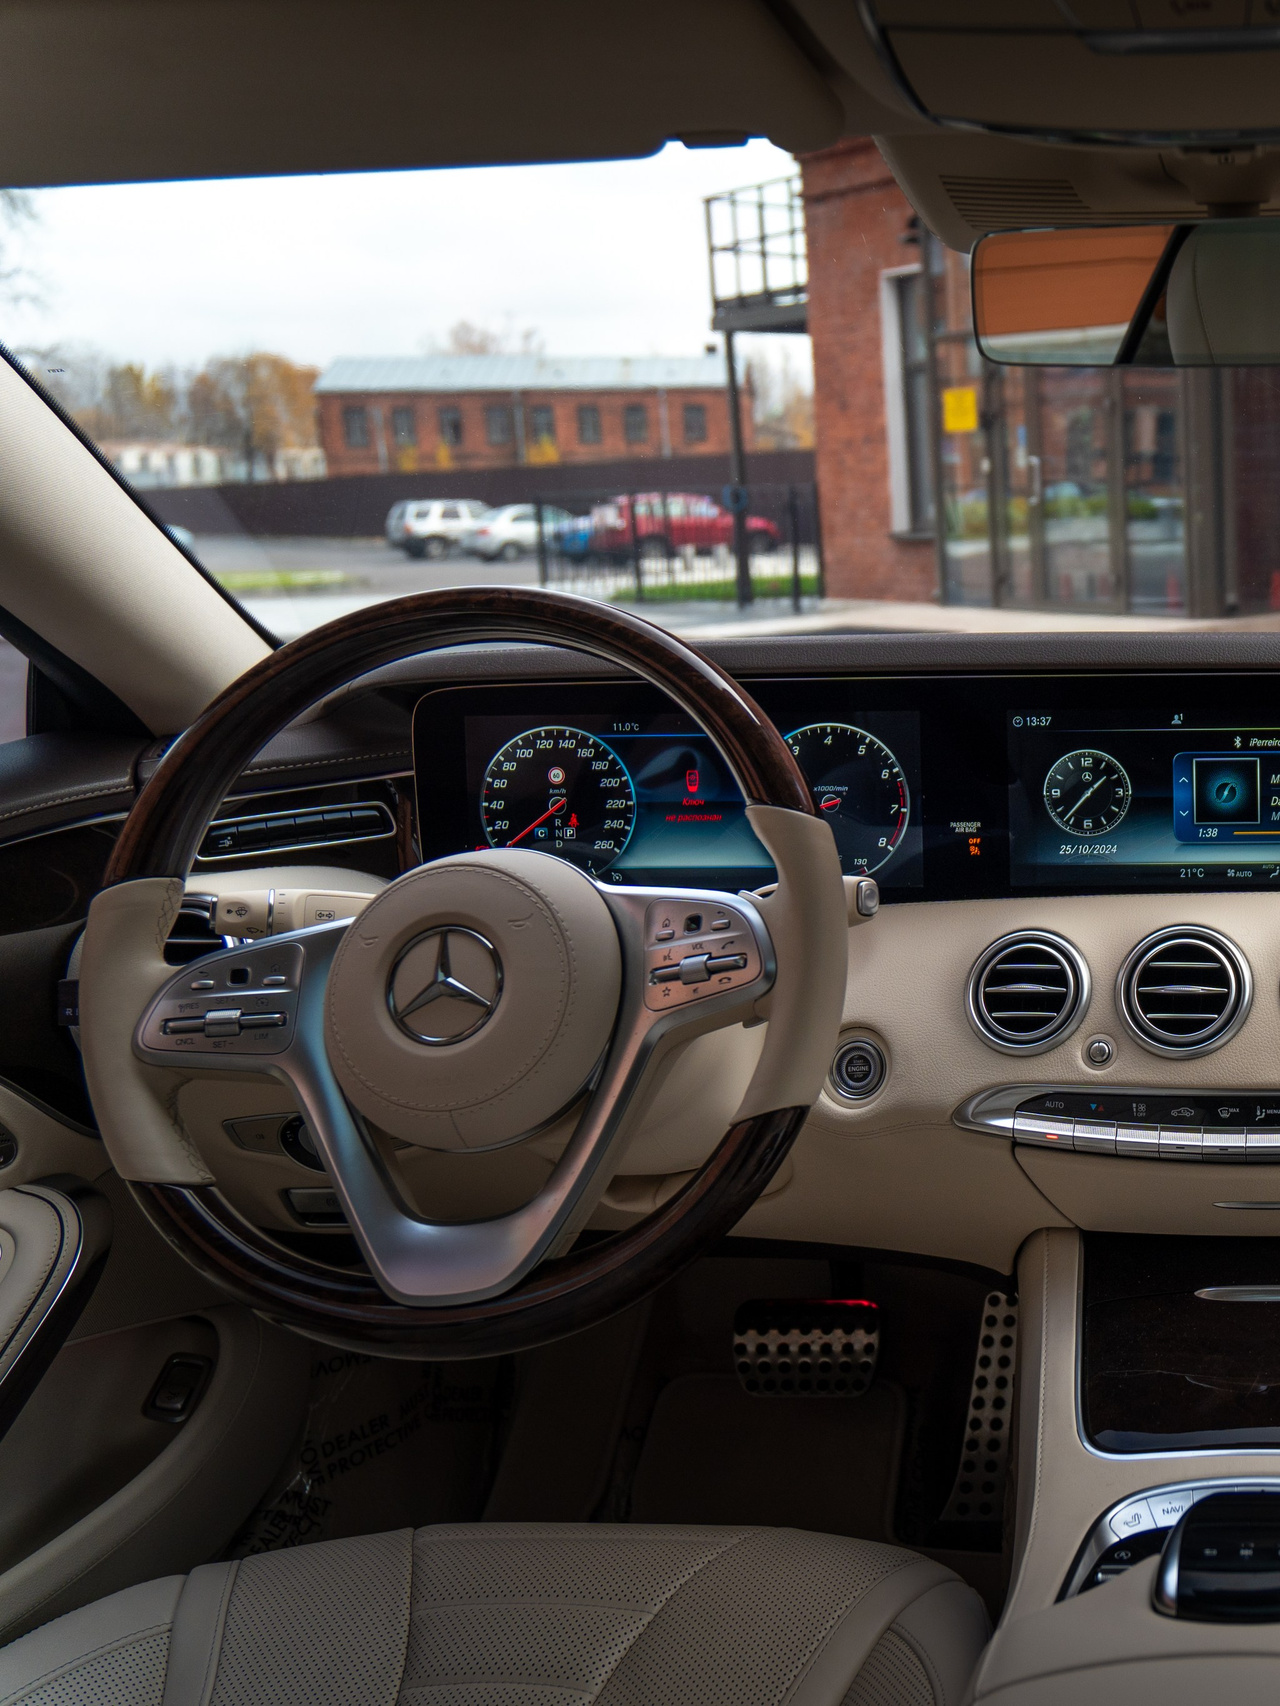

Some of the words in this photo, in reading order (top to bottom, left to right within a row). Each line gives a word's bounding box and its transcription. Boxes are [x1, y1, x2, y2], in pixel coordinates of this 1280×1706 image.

[1026, 717, 1052, 726] 13:37
[536, 740, 554, 748] 120
[558, 740, 576, 748] 140
[824, 736, 833, 745] 4
[516, 749, 533, 758] 100
[577, 748, 594, 758] 160
[793, 746, 800, 755] 3
[858, 746, 866, 755] 5
[503, 762, 516, 771] 80
[592, 761, 608, 770] 180
[1081, 758, 1092, 767] 12
[881, 769, 889, 779] 6
[494, 779, 507, 788] 60
[600, 778, 620, 787] 200
[1052, 789, 1061, 798] 9
[1116, 789, 1124, 798] 3
[490, 800, 504, 809] 40
[606, 800, 625, 809] 220
[890, 805, 899, 814] 7
[495, 820, 509, 829] 20
[556, 819, 562, 827] R
[604, 820, 624, 829] 240
[1084, 820, 1093, 829] 6
[538, 830, 545, 838] C
[556, 830, 562, 838] N
[1198, 828, 1218, 838] 1:38
[556, 840, 563, 848] D
[594, 840, 614, 849] 260
[878, 838, 887, 847] 8
[1059, 845, 1118, 855] 25/10/2024
[1180, 868, 1204, 878] 21°C
[1045, 1101, 1064, 1109] AUTO
[1162, 1505, 1184, 1515] NAVI
